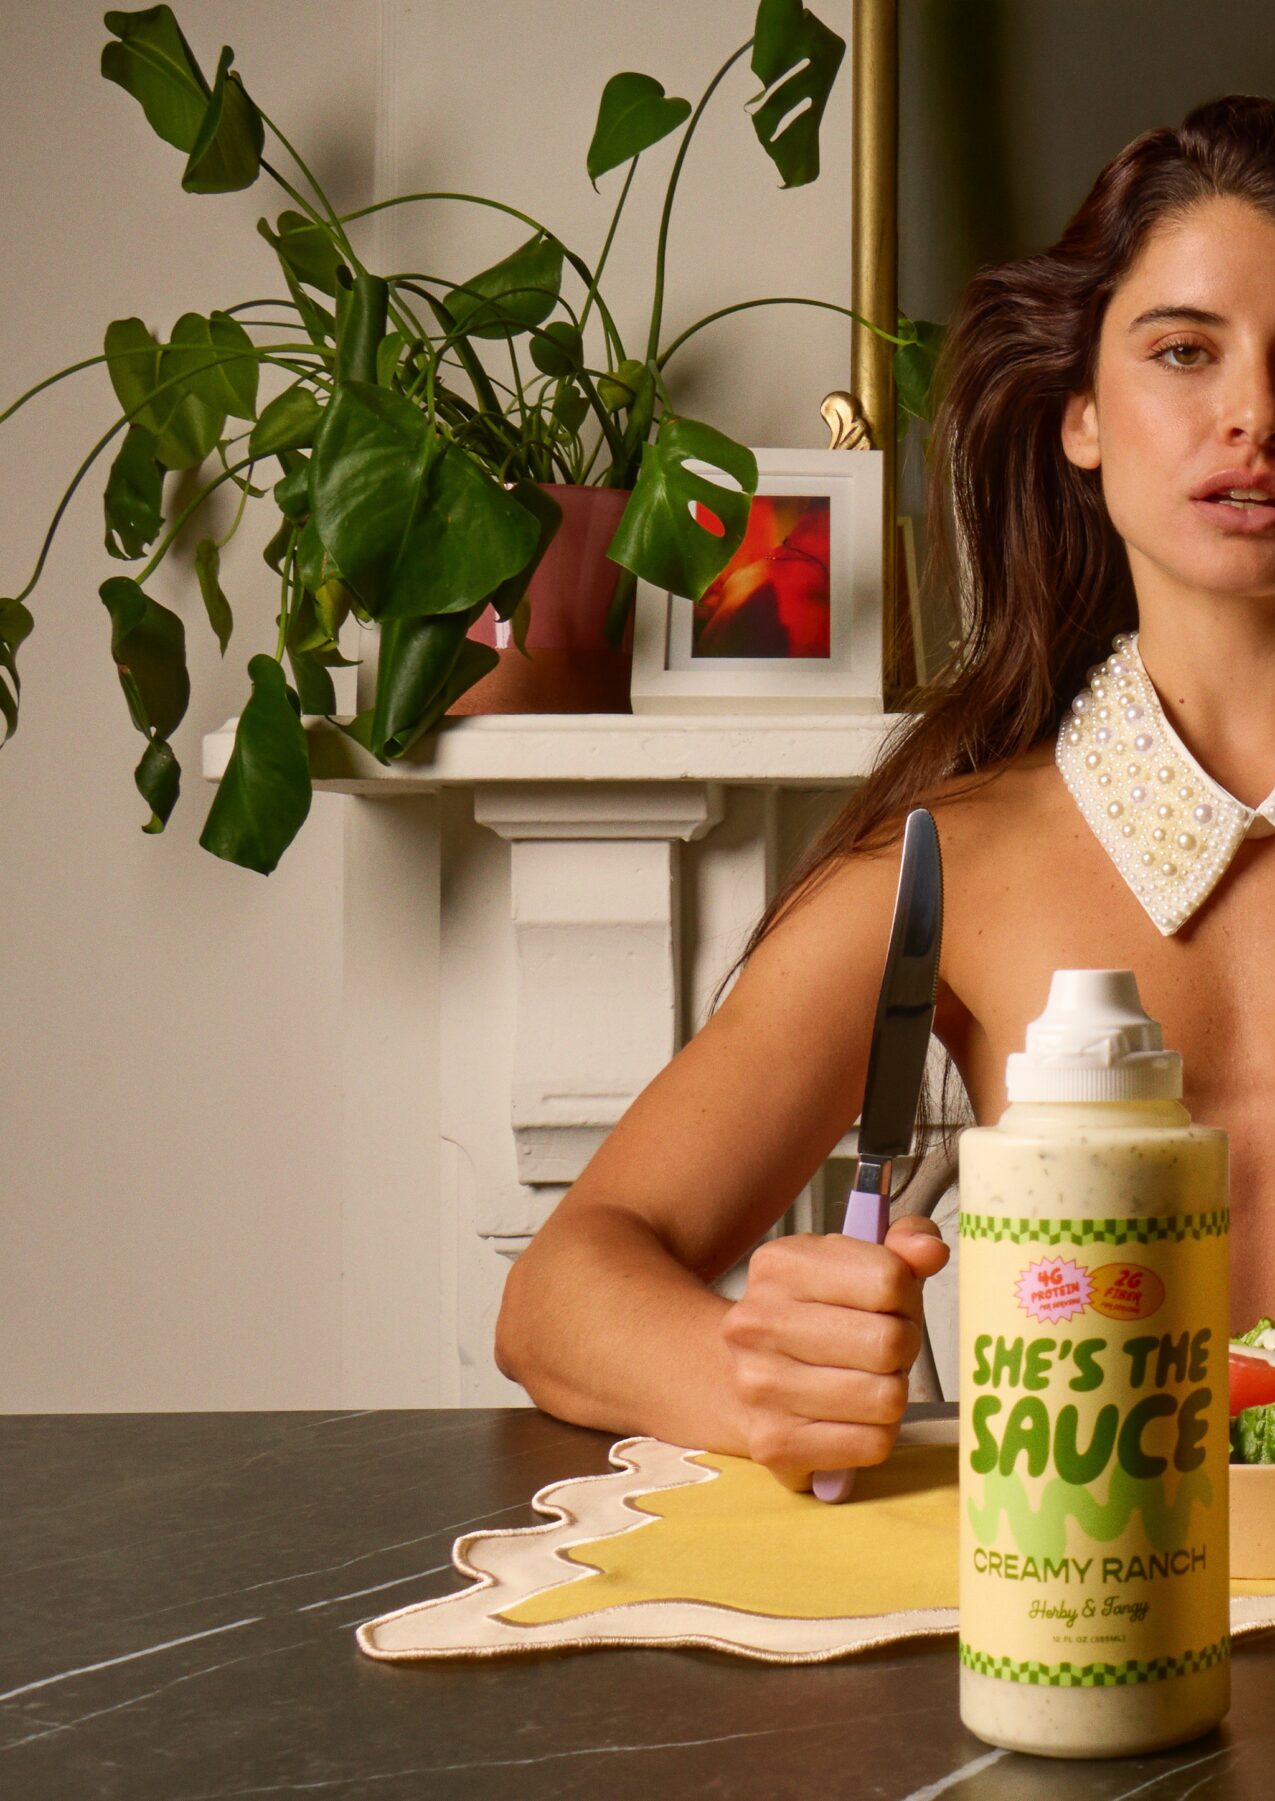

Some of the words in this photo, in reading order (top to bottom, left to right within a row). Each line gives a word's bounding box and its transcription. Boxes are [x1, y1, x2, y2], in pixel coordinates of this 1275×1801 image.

[1038, 1267, 1063, 1287] 4G
[1114, 1269, 1144, 1289] 2G
[1031, 1281, 1080, 1303] PROTEIN
[1104, 1287, 1143, 1306] FIBER
[973, 1334, 1107, 1392] SHE'S
[1123, 1328, 1211, 1388] THE
[970, 1387, 1213, 1485] SAUCE
[973, 1548, 1093, 1584] CREAMY
[1102, 1544, 1207, 1583] RANCH
[1028, 1599, 1079, 1628] Herby
[1082, 1598, 1096, 1618] &
[1101, 1596, 1150, 1623] Tangy
[1063, 1635, 1073, 1643] FL
[1076, 1635, 1088, 1643] OZ
